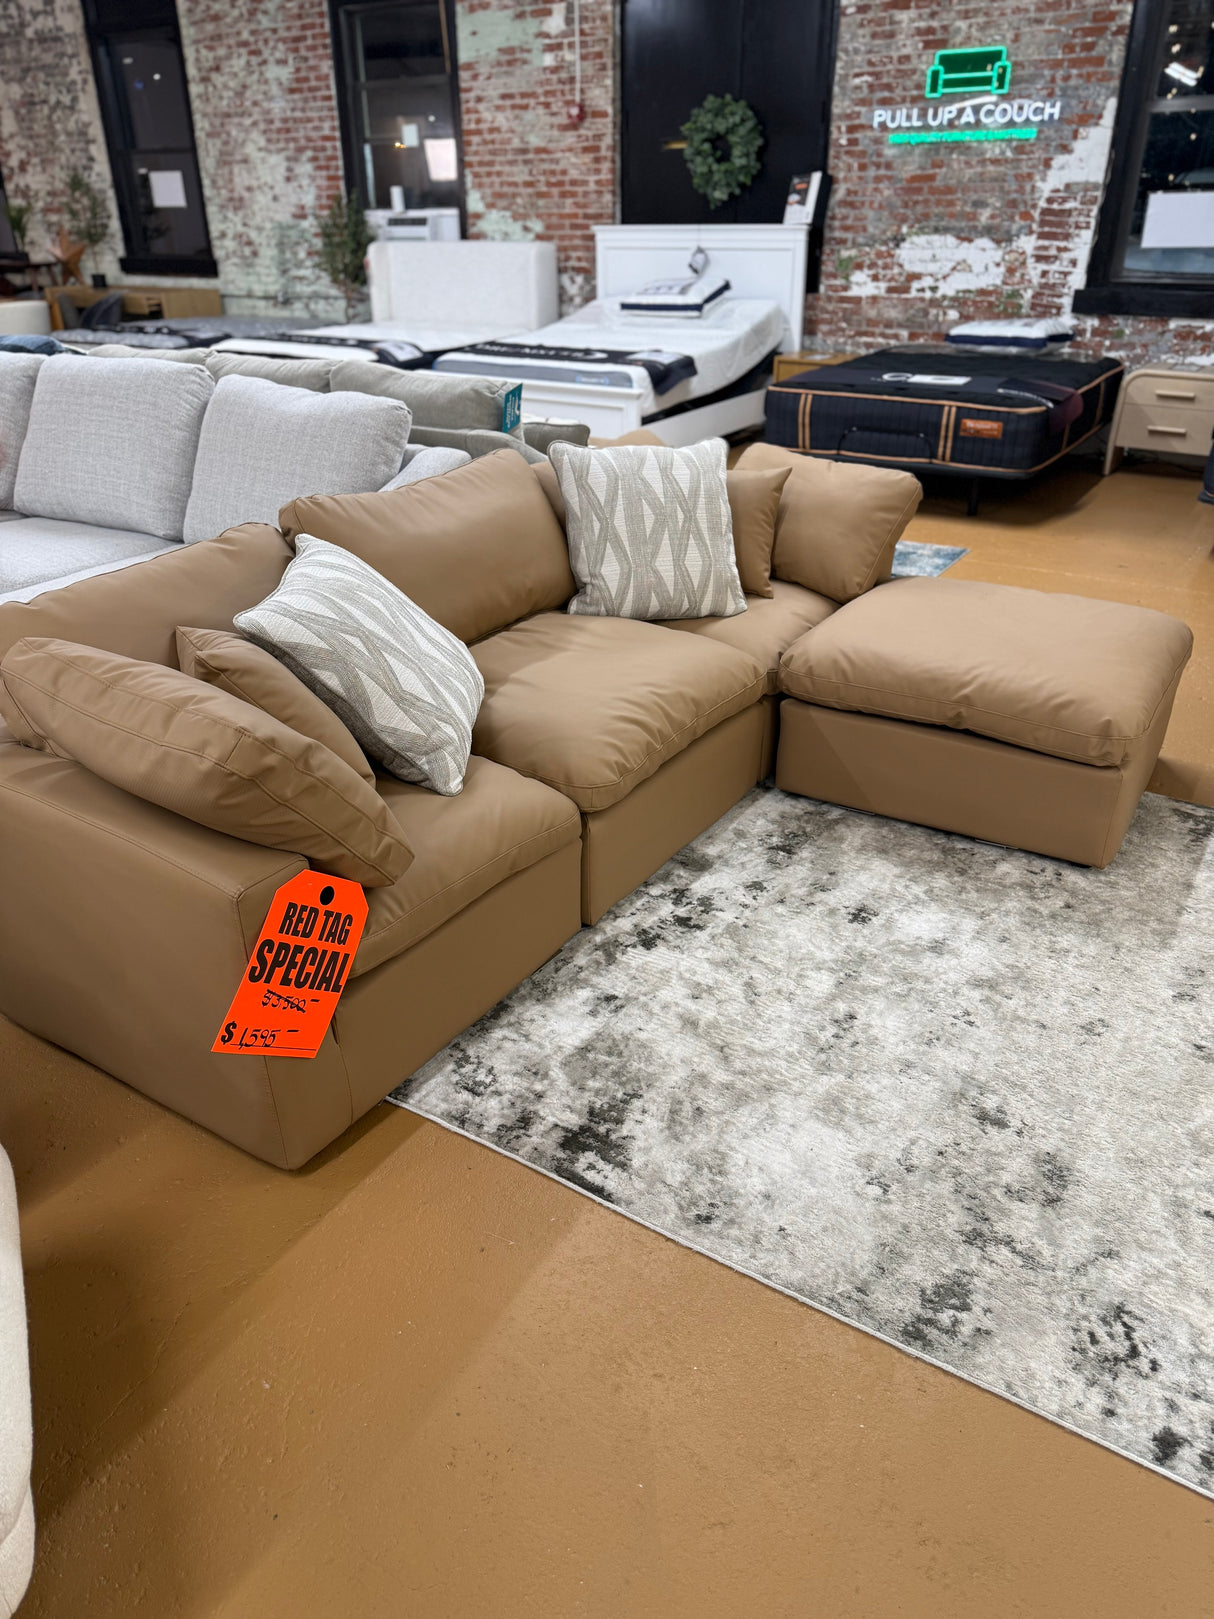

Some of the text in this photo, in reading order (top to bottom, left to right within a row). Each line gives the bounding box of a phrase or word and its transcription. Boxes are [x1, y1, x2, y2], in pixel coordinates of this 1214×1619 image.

[873, 101, 1062, 128] PULL UP A COUCH
[278, 901, 353, 946] RED TAG
[248, 938, 350, 993] SPECIAL
